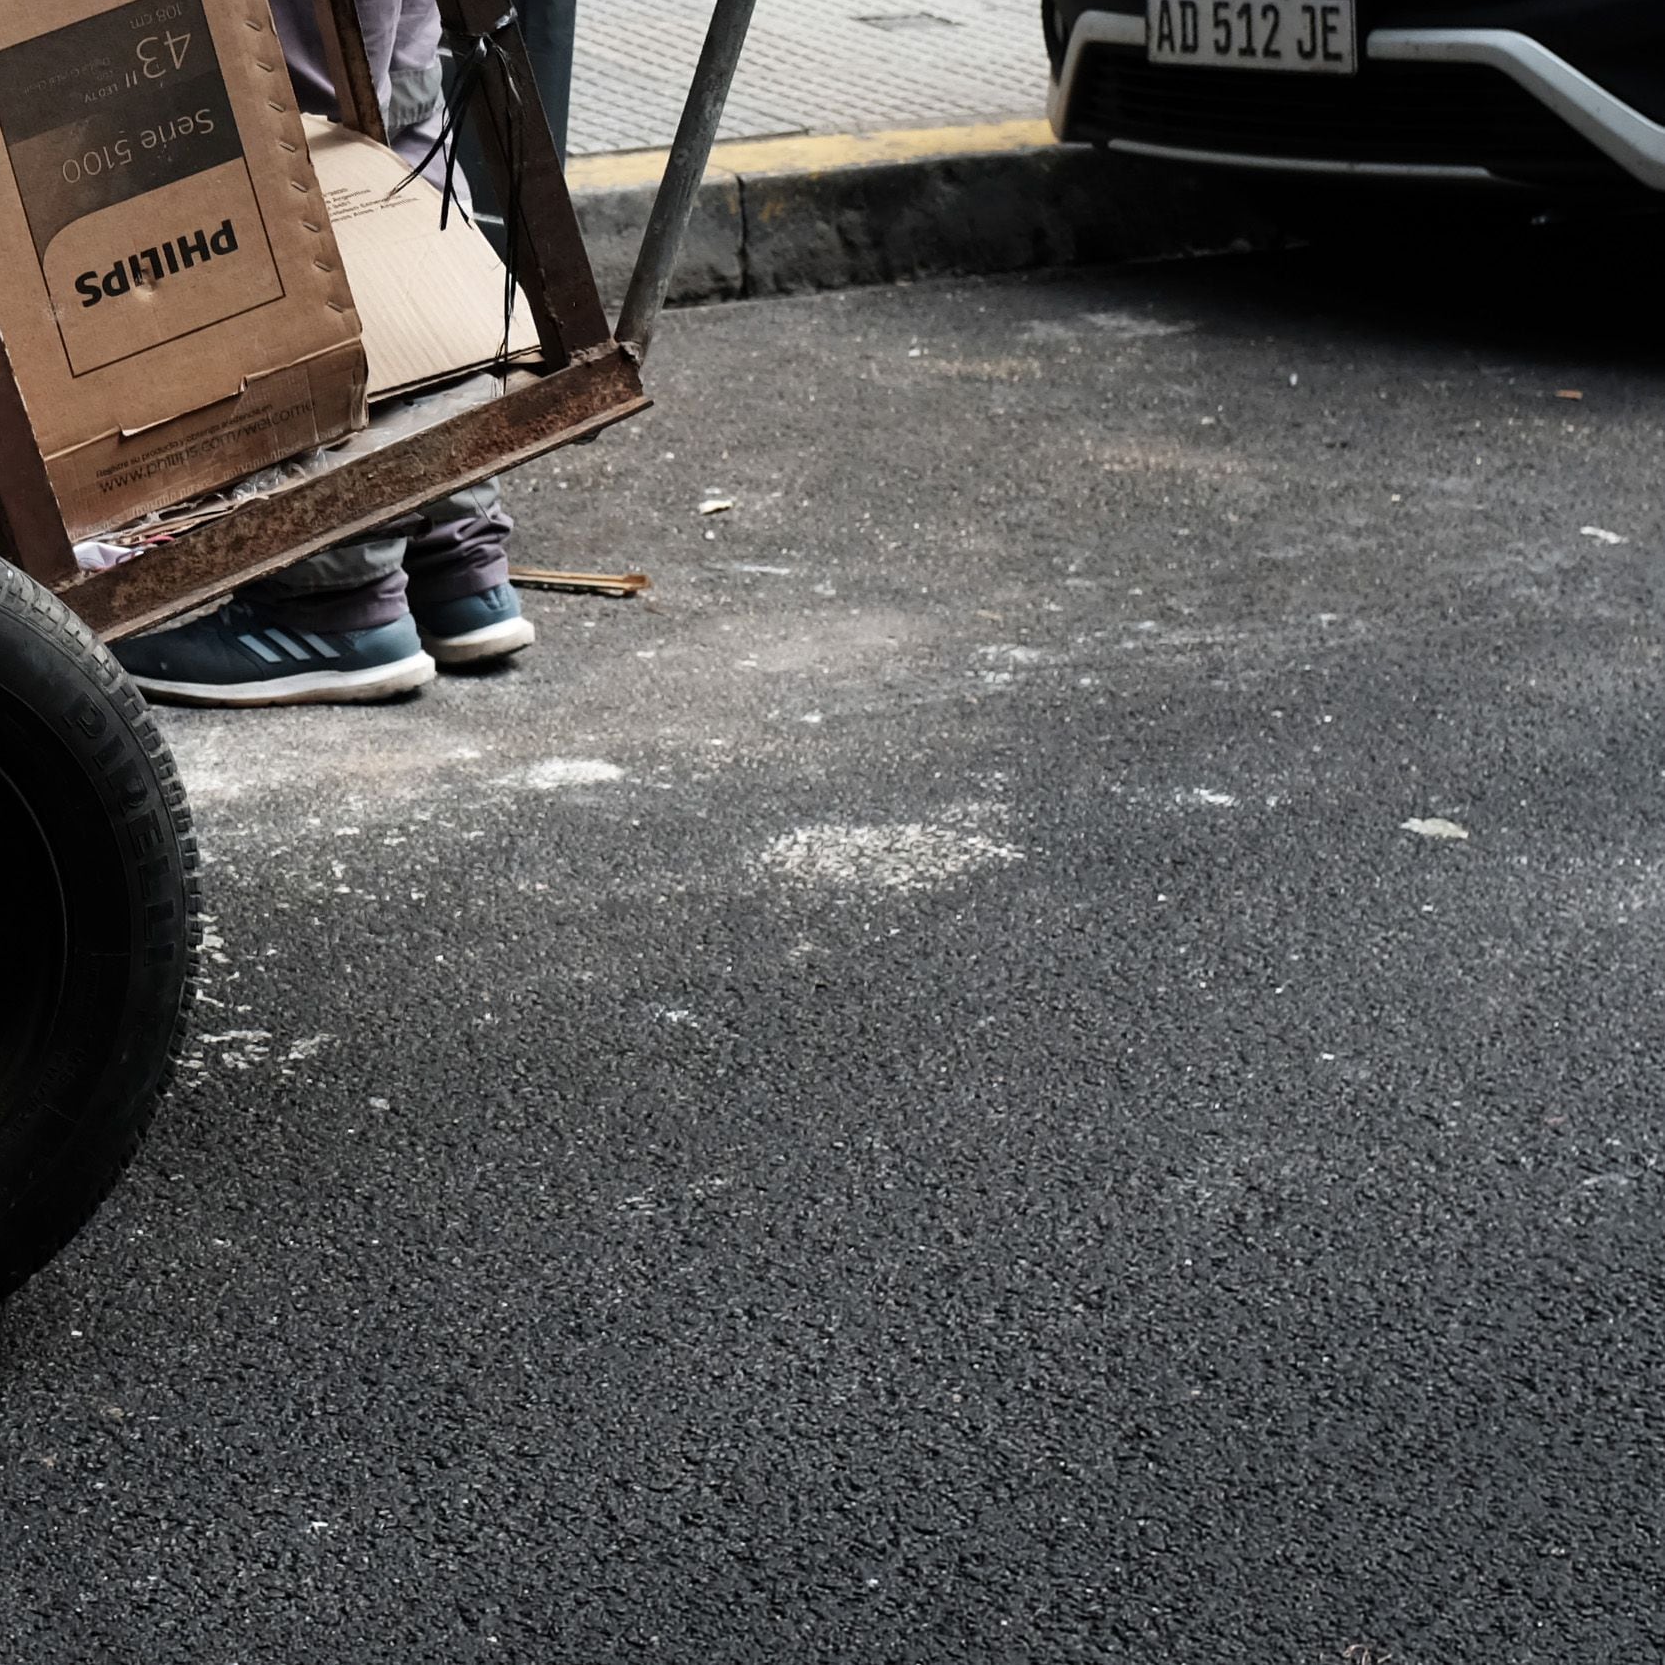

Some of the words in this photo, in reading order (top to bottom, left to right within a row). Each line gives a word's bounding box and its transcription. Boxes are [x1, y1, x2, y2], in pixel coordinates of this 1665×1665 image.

[155, 3, 182, 21] 108
[1157, 0, 1199, 54] AD
[1213, 1, 1281, 59] 512
[1297, 5, 1343, 63] JE
[141, 109, 213, 148] Serie
[58, 138, 134, 183] 5100
[75, 219, 238, 307] PHILIPS
[99, 400, 315, 493] www.philips.com/welcome
[63, 690, 175, 973] PIRELLI
